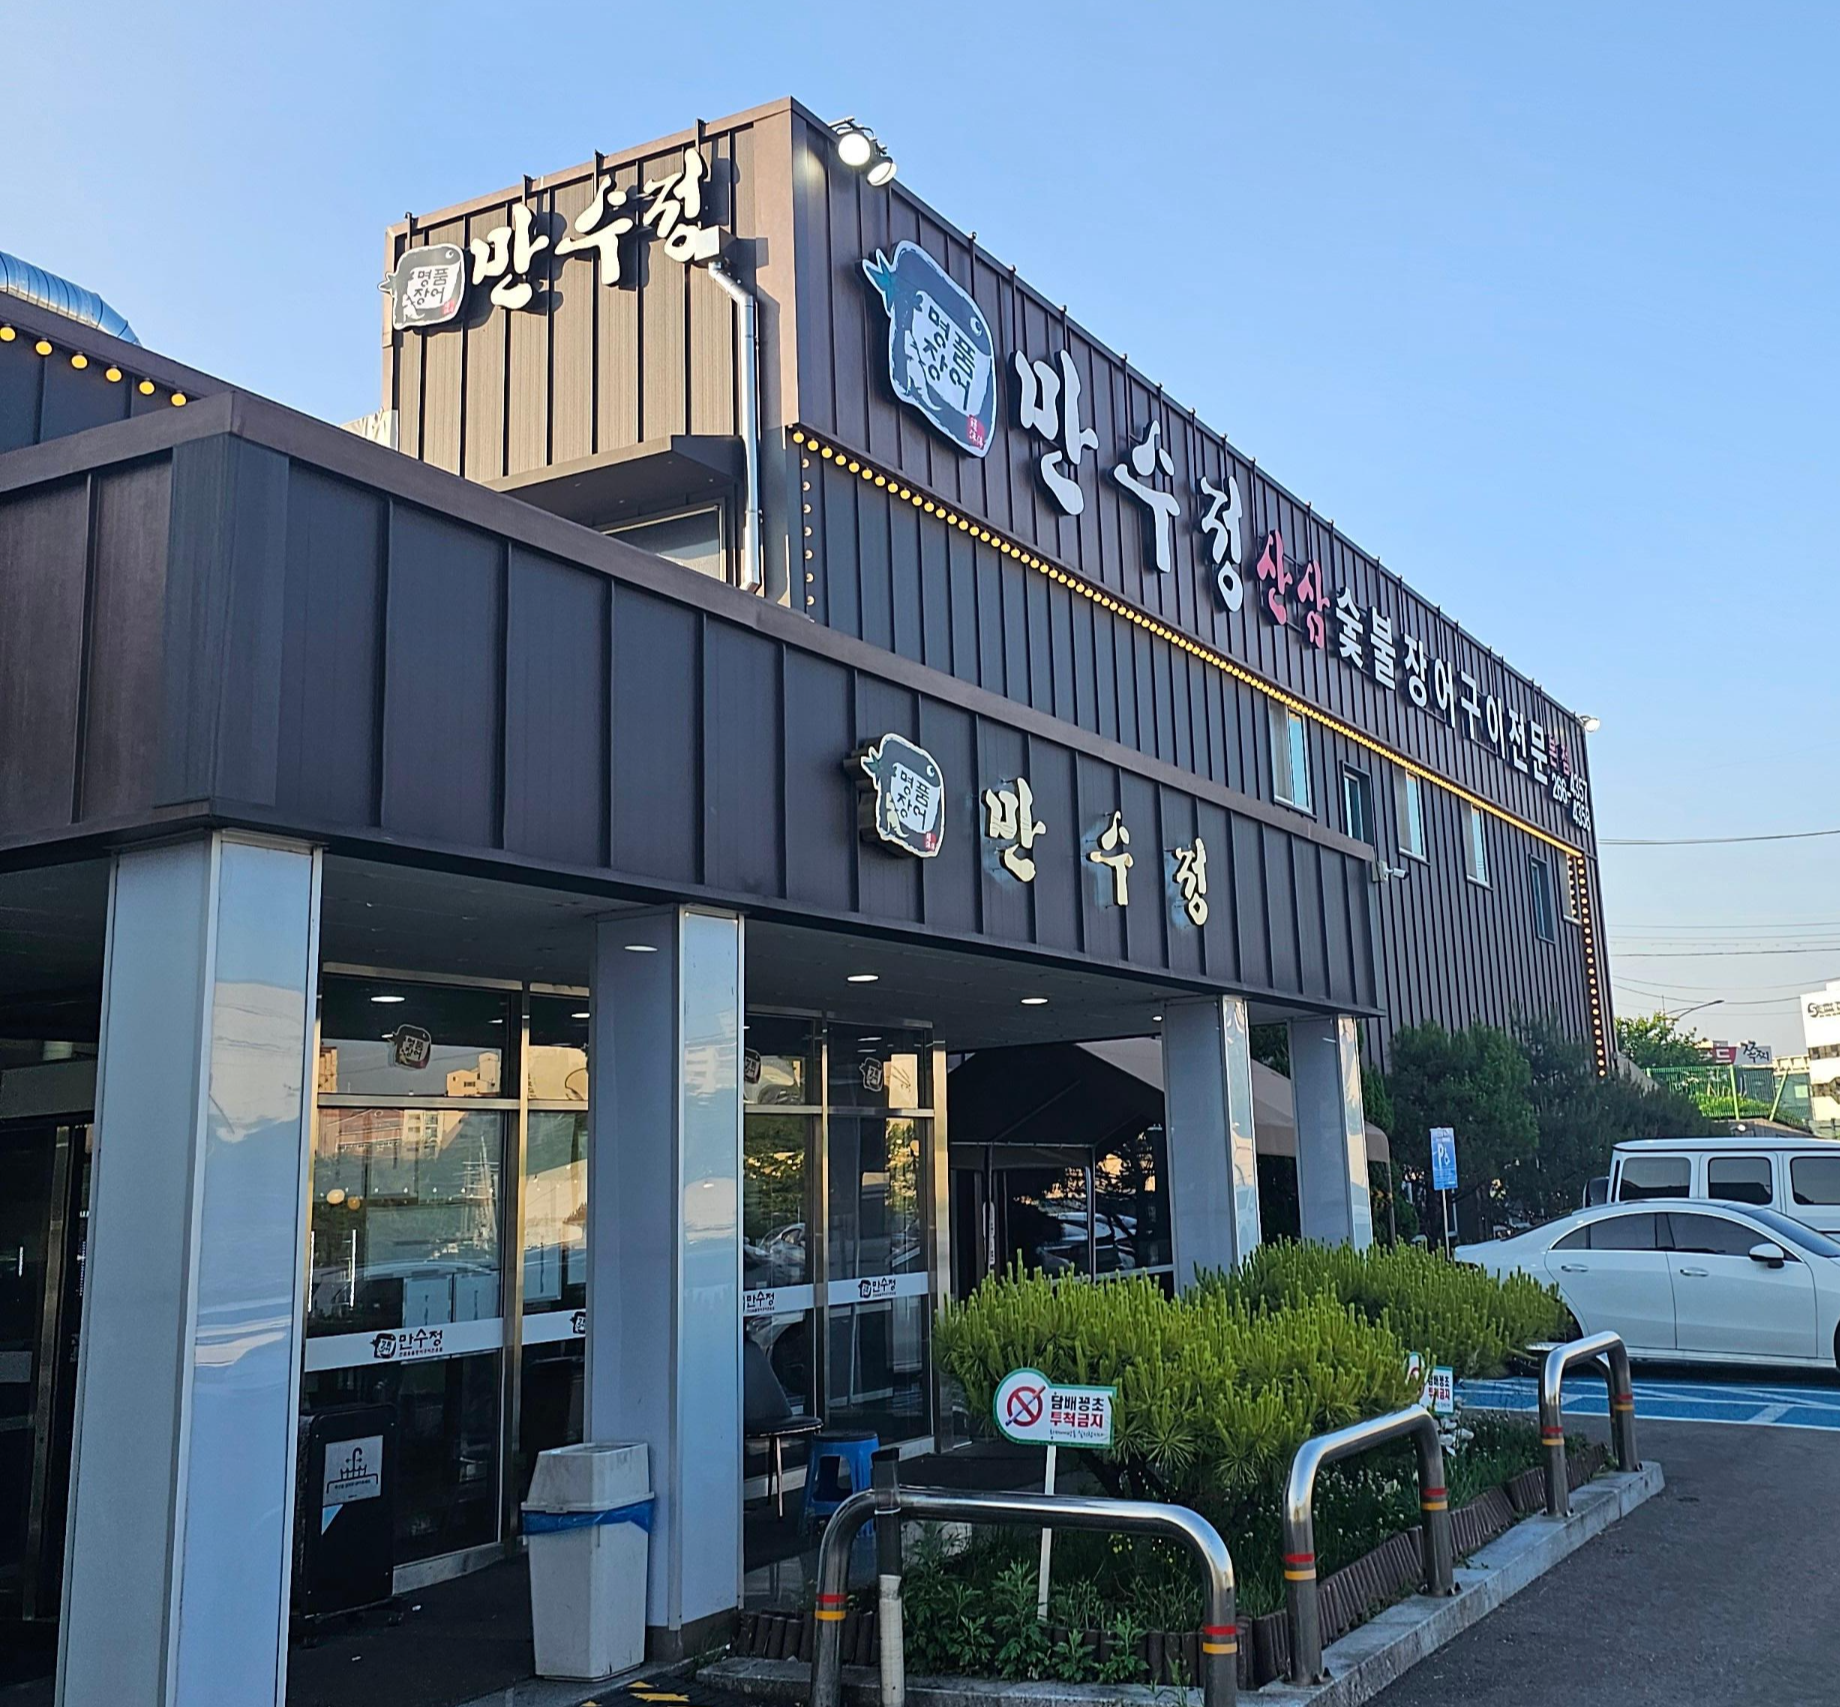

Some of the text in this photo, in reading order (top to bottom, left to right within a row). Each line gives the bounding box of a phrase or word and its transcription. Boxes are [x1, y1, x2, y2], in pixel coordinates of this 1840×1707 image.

[470, 149, 708, 310] 만수정
[417, 267, 449, 288] 명품
[413, 287, 445, 306] 장어
[928, 305, 976, 381] 명품
[923, 337, 971, 411] 장어
[1014, 349, 1244, 612] 만수정
[1257, 530, 1330, 648] 산삼
[900, 769, 931, 809] 명품
[897, 792, 927, 831] 장어
[985, 777, 1209, 926] 만수정
[746, 1290, 775, 1308] 만수정
[872, 1277, 897, 1293] 만수정
[399, 1328, 443, 1350] 만수정
[1051, 1395, 1104, 1412] 담배꽁초
[1050, 1411, 1103, 1428] 투척금지
